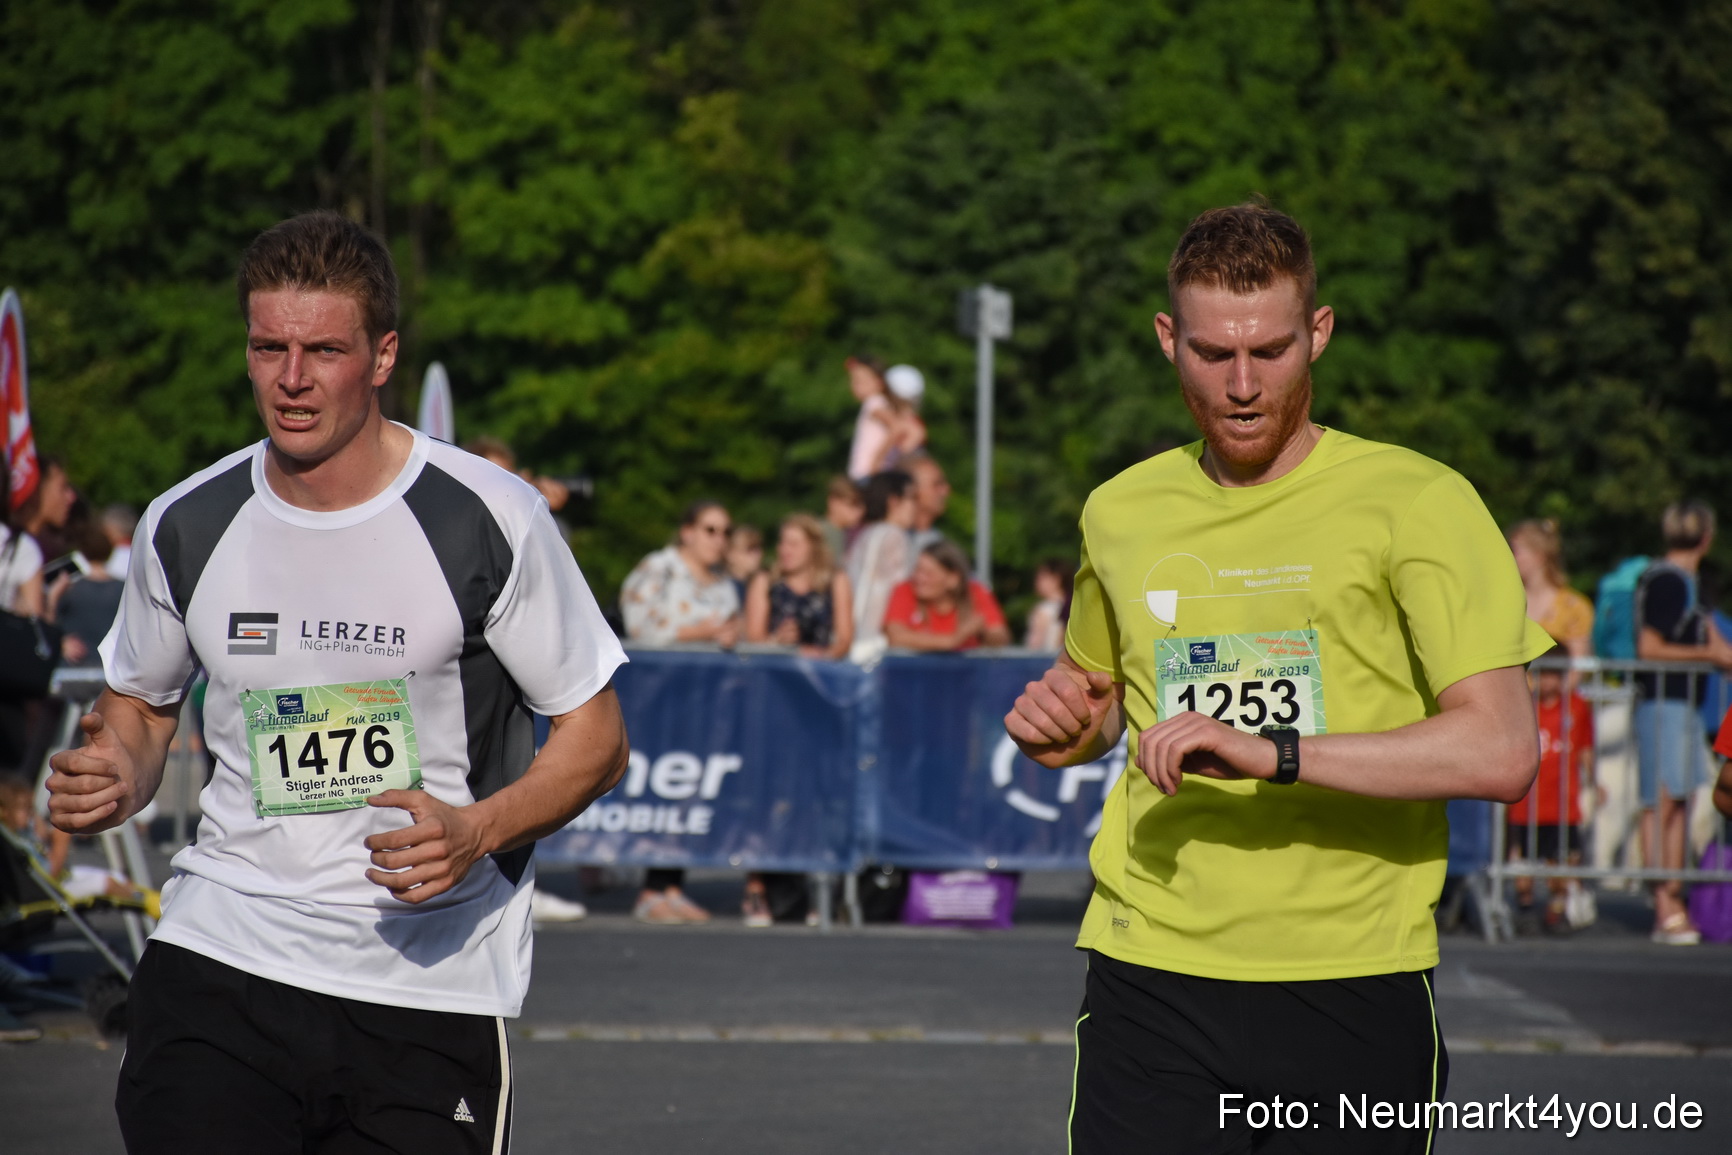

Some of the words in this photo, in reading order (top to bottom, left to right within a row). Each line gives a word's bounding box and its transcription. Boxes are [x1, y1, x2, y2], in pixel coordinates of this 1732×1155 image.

[1218, 568, 1253, 578] Kliniken
[1255, 567, 1269, 577] des
[1270, 564, 1313, 575] Landkreises
[1244, 576, 1281, 588] Neumarkt
[301, 620, 406, 646] LERZER
[300, 639, 359, 653] ING+Plan
[364, 643, 406, 658] GmbH
[1179, 659, 1241, 676] firmenlauf
[1279, 665, 1310, 677] 2019
[1178, 679, 1301, 729] 1253
[268, 709, 330, 726] firmenlauf
[370, 711, 401, 724] 2019
[268, 724, 395, 779] 1476
[286, 780, 326, 793] Stigler
[330, 774, 384, 788] Andreas
[299, 791, 327, 801] Lerzer
[328, 790, 345, 798] ING
[351, 787, 371, 796] Plan
